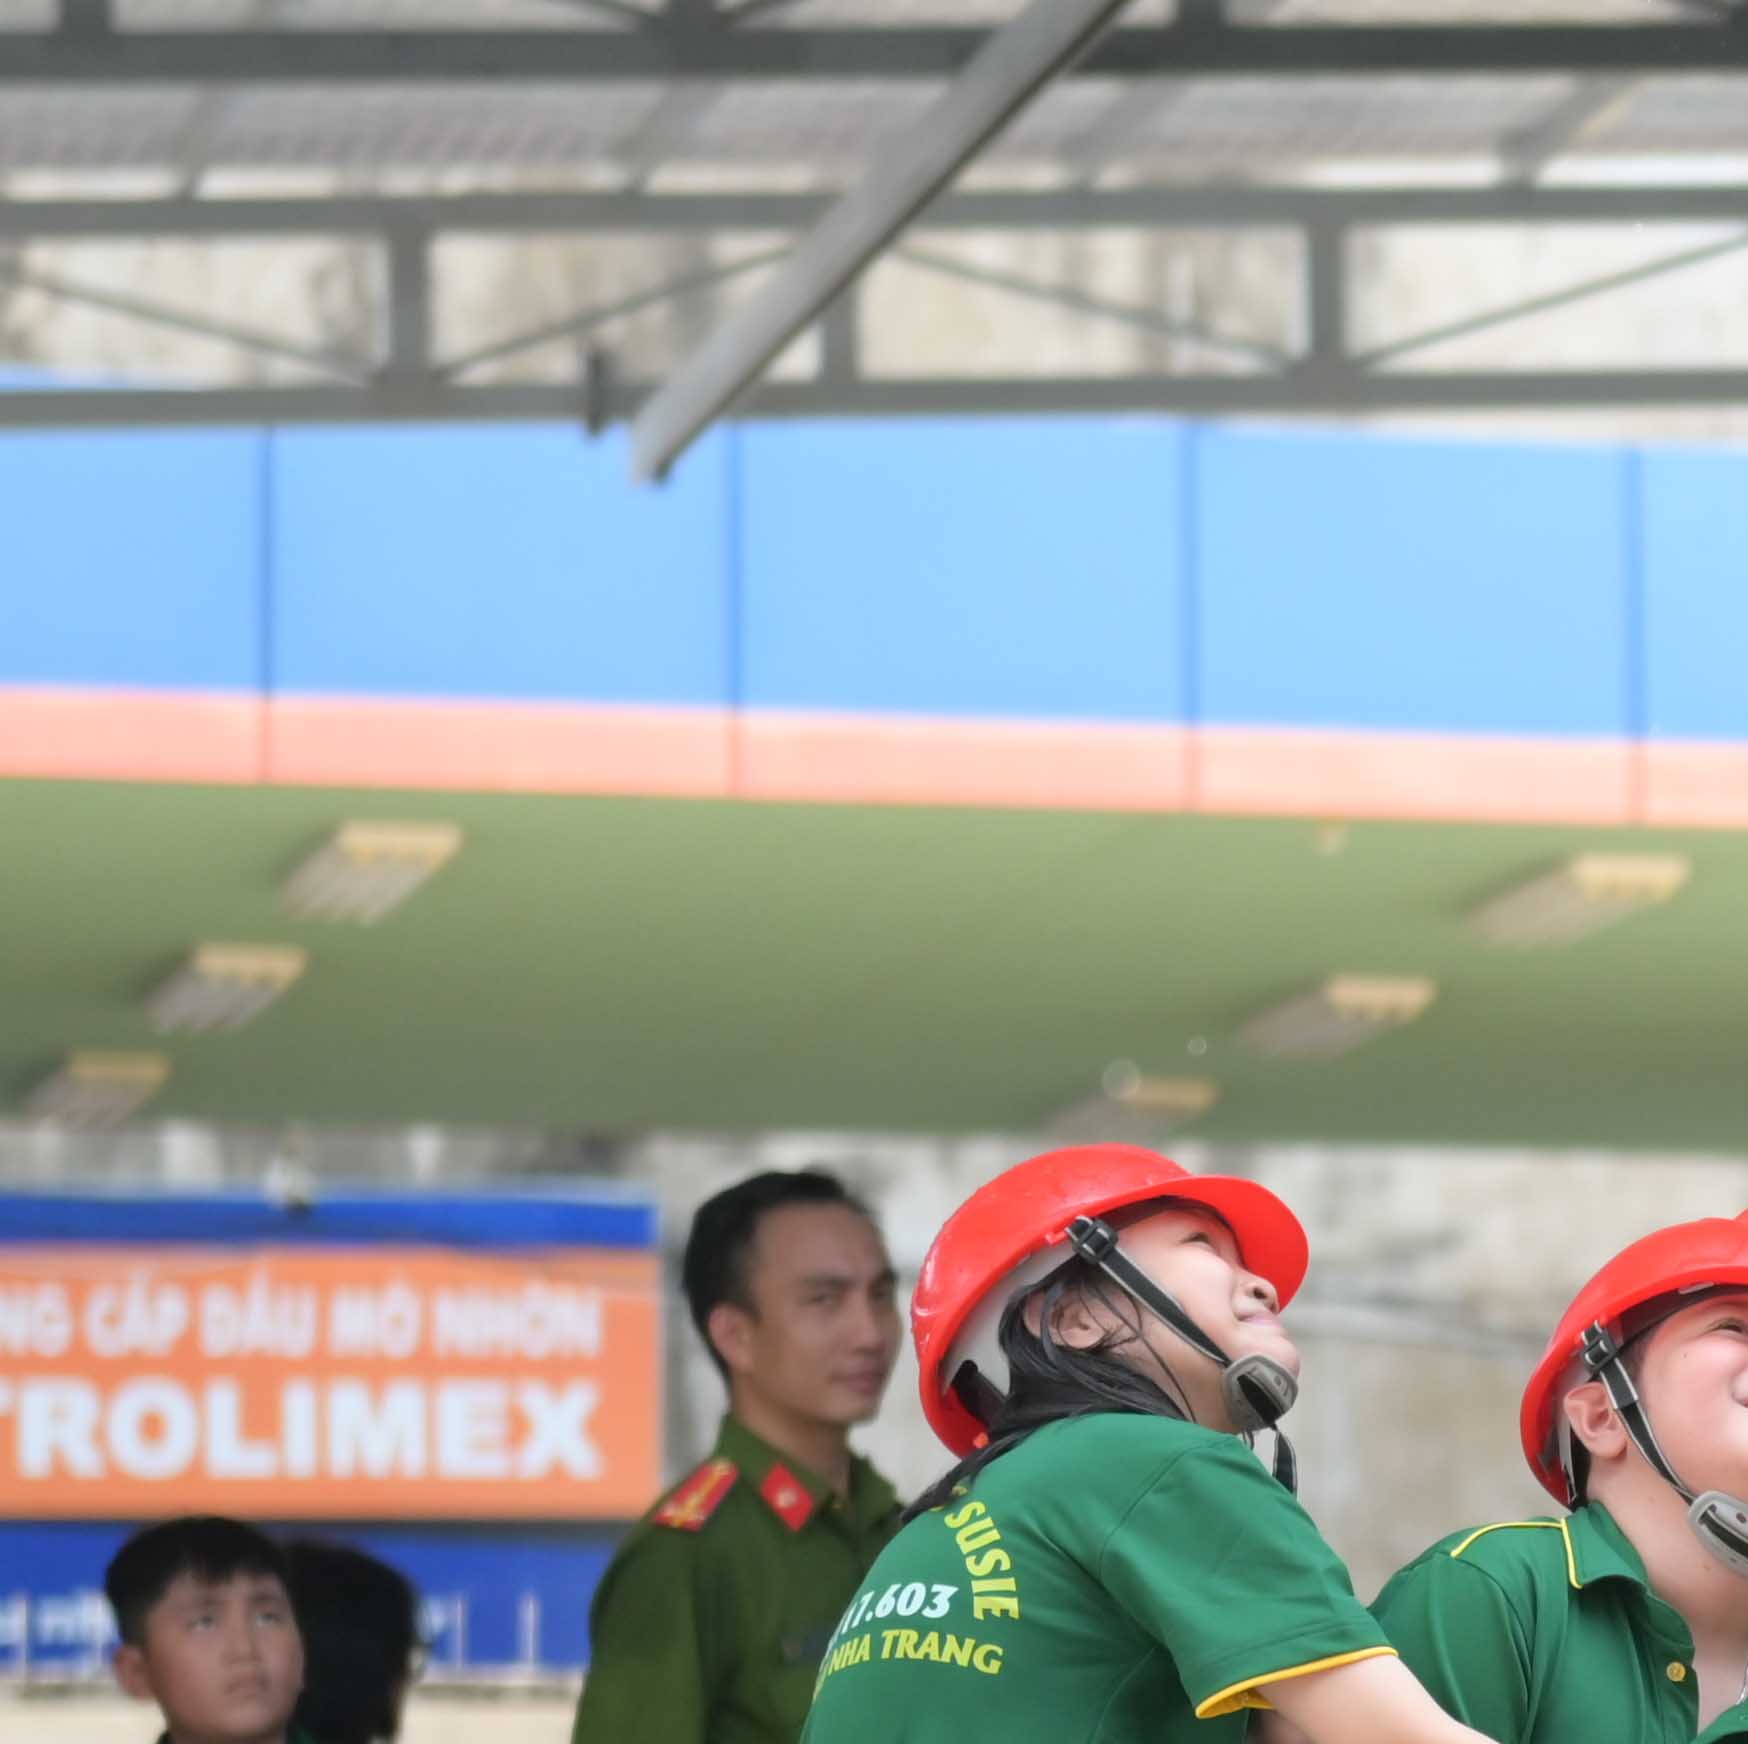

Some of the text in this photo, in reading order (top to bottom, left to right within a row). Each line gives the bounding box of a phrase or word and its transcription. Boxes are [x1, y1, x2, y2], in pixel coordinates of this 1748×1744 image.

[0, 1378, 605, 1480] ROLIMEX
[944, 1501, 1020, 1621] SUSIE
[881, 1628, 1004, 1675] TRANG
